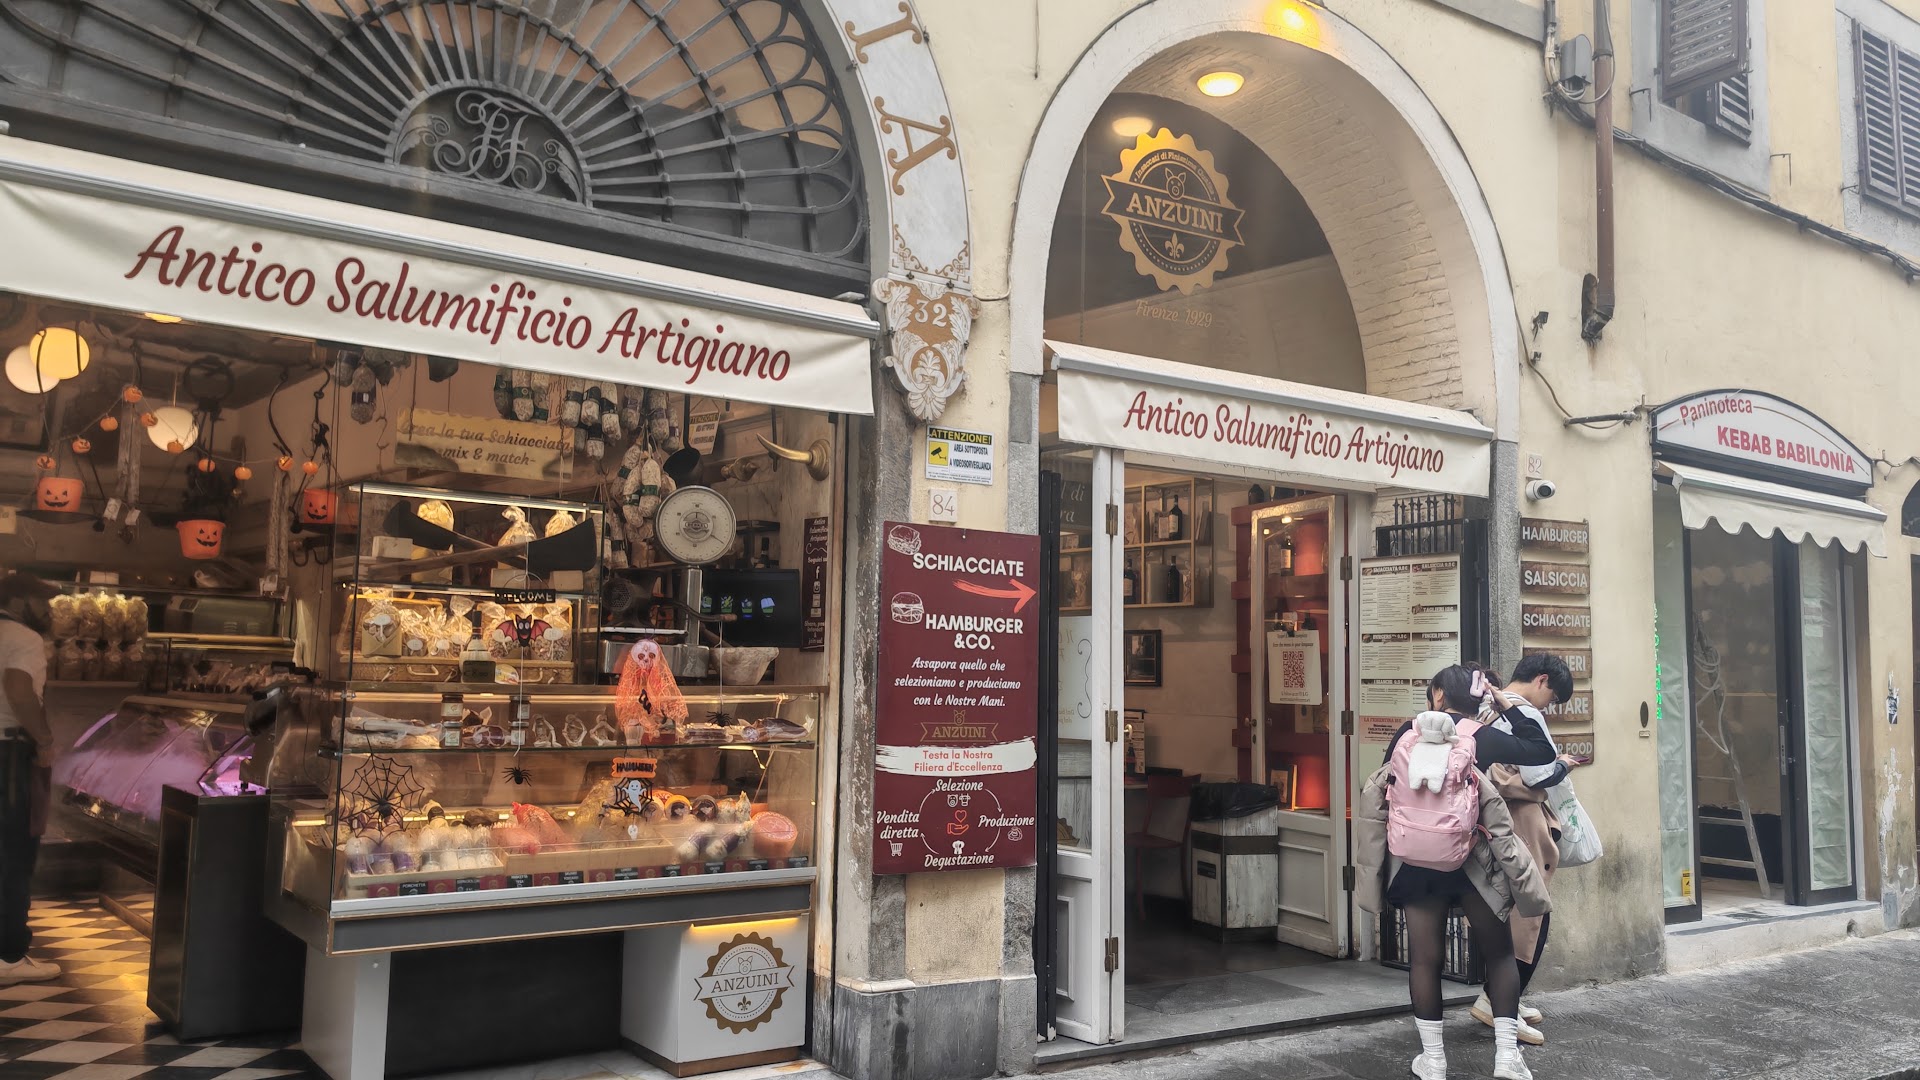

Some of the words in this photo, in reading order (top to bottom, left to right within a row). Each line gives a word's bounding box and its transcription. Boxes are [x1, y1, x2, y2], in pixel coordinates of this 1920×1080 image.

[1126, 192, 1223, 233] ANZUINI
[124, 225, 316, 306] Antico
[327, 256, 593, 351] Salumificio
[597, 306, 791, 385] Artigiano
[914, 299, 948, 327] 32
[1135, 299, 1179, 321] Firenze
[1185, 307, 1213, 327] 1929
[1679, 394, 1753, 426] Paninoteca
[440, 422, 454, 438] la
[459, 428, 484, 442] tua
[931, 429, 991, 444] ATTENZIONE!
[1123, 391, 1209, 439] Antico
[1213, 403, 1341, 459] Salumificio
[1344, 426, 1444, 479] Artigiano
[472, 448, 483, 460] &
[953, 443, 964, 453] AREA
[964, 444, 988, 455] SOTTOPOSTA
[1717, 425, 1772, 456] KEBAB
[1776, 439, 1856, 474] BABILONIA
[949, 458, 953, 466] A
[953, 459, 992, 471] VIDEOSORVEGLIANZA
[1527, 456, 1542, 474] 82
[932, 494, 955, 516] 84
[1522, 526, 1588, 545] HAMBURGER
[912, 553, 1024, 577] SCHIACCIATE
[1524, 570, 1588, 587] SALSICCIA
[925, 613, 1023, 635] HAMBURGER
[1523, 613, 1591, 628] SCHIACCIATE
[953, 633, 995, 651] &CO.
[911, 656, 957, 672] Assapora
[959, 658, 987, 673] quello
[989, 659, 1005, 671] che
[894, 674, 956, 687] selezioniamo
[958, 678, 964, 687] e
[966, 676, 1021, 691] produciamo
[913, 696, 931, 706] con
[933, 694, 943, 706] le
[945, 694, 976, 706] Nostre
[978, 695, 1006, 707] Mani.
[932, 727, 987, 738] ANZUINI
[923, 750, 949, 760] Testa
[952, 750, 960, 759] la
[963, 750, 993, 759] Nostra
[1566, 742, 1592, 754] FOOD
[914, 763, 944, 772] Filiera
[946, 762, 1003, 772] d'Eccellenza
[935, 779, 984, 791] Selezione
[876, 810, 920, 824] Vendita
[978, 814, 1035, 828] Produzione
[880, 826, 919, 839] diretta
[925, 852, 995, 870] Degustazione
[711, 972, 779, 993] ANZUINI
